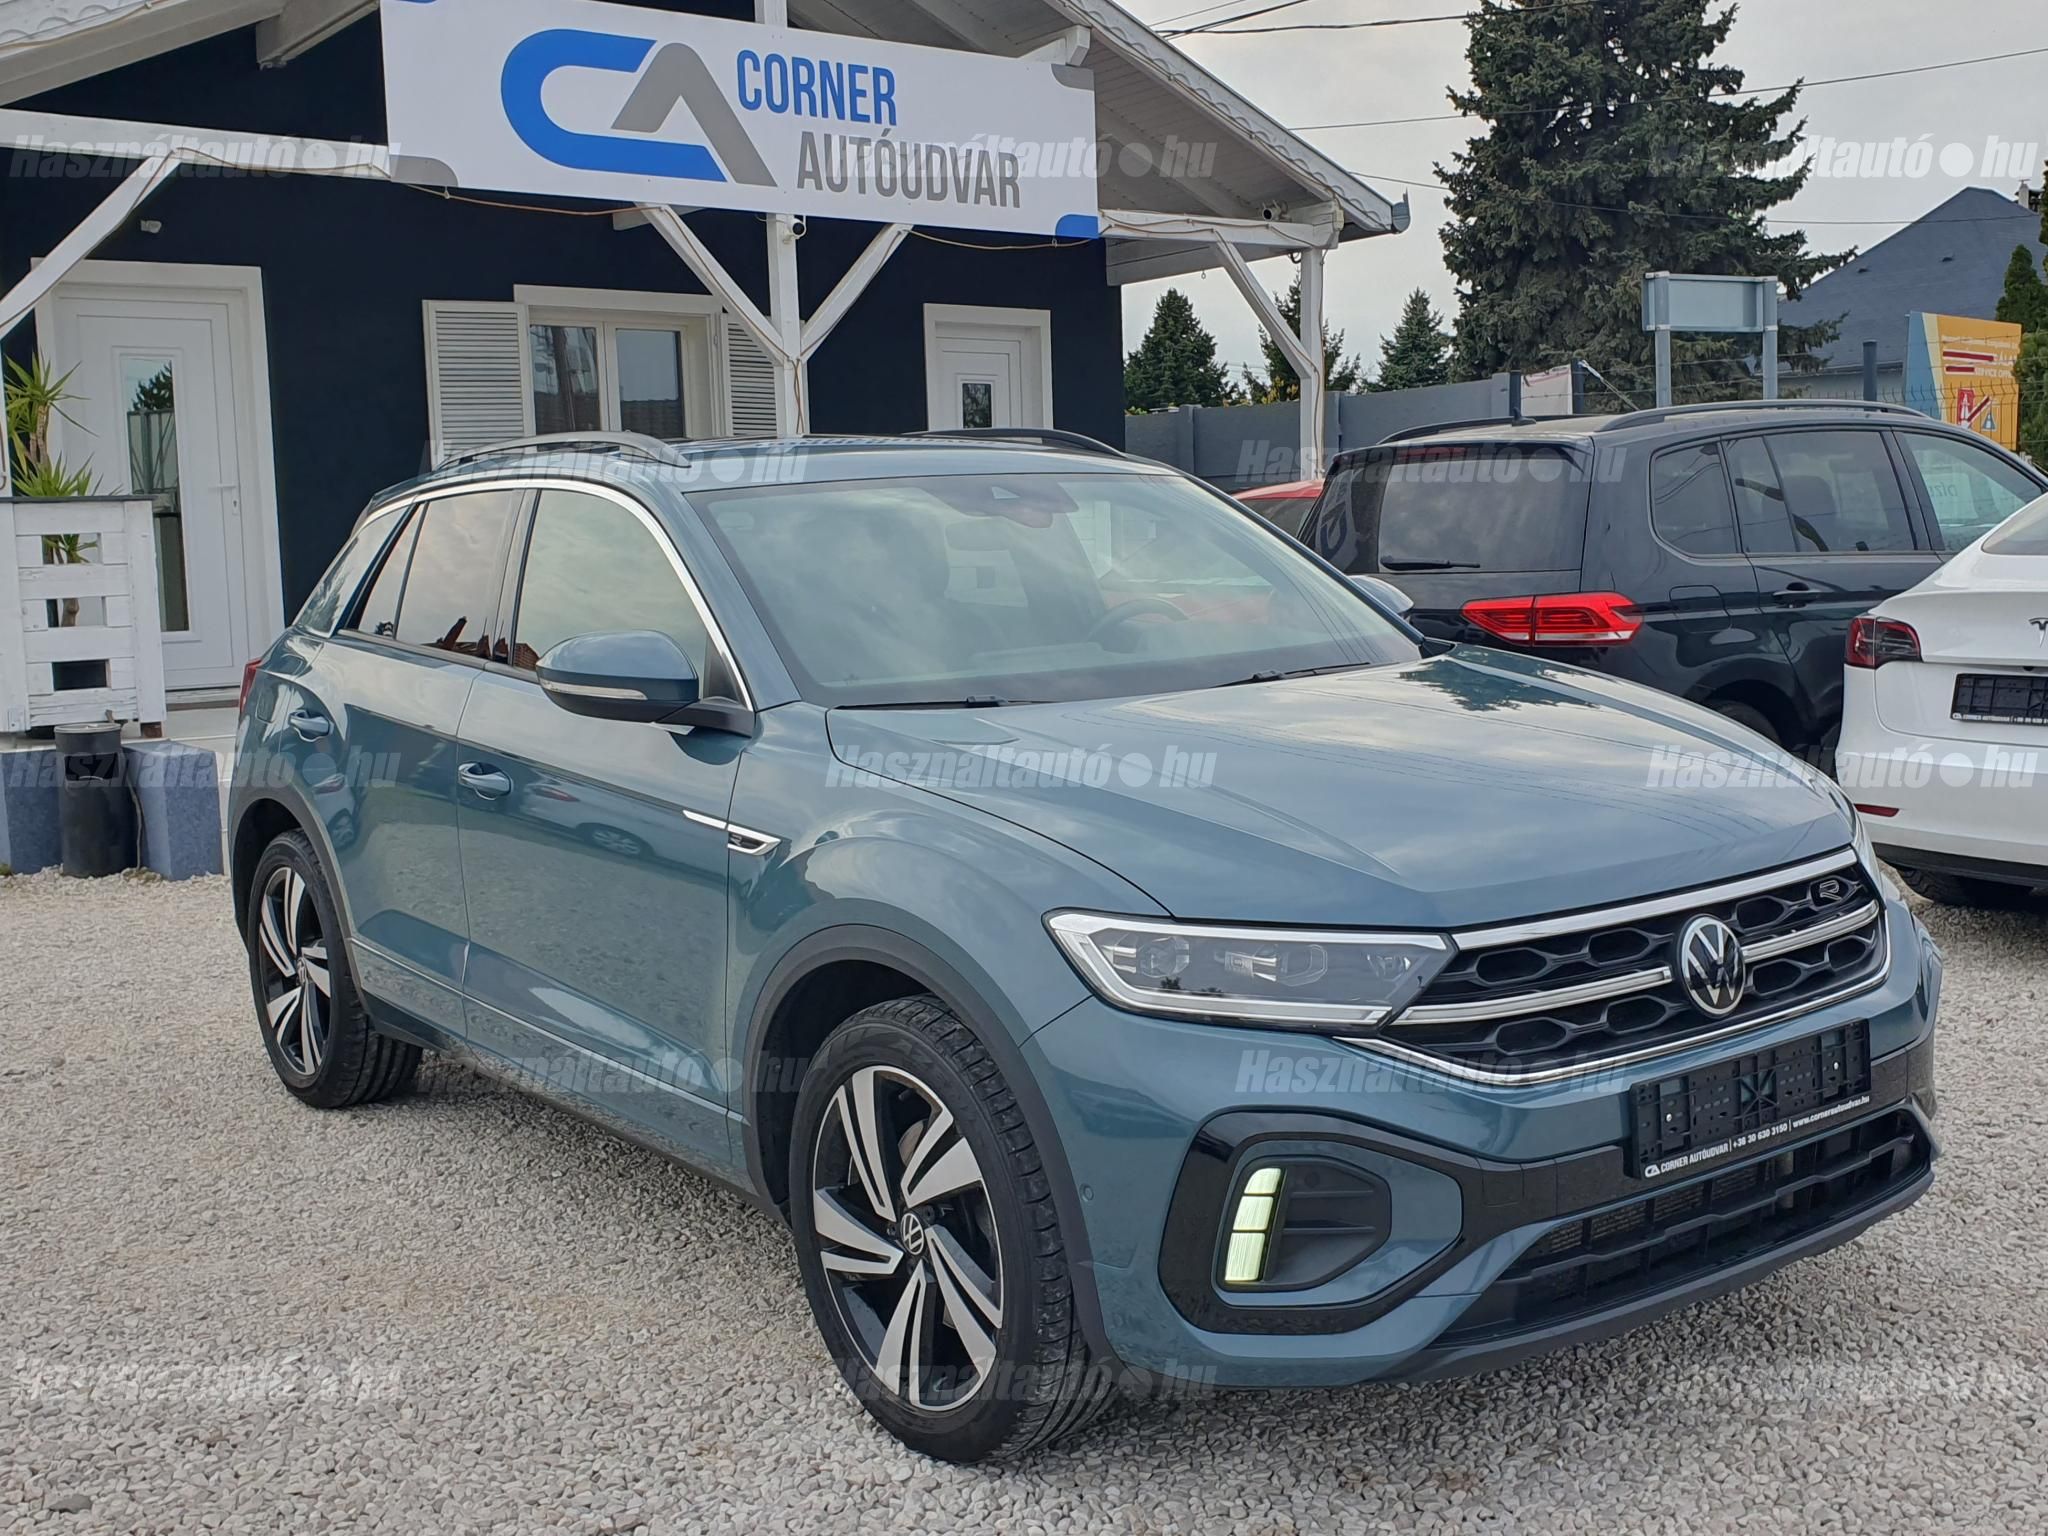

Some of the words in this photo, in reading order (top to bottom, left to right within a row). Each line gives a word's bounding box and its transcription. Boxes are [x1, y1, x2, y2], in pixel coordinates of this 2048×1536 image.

[737, 49, 897, 126] CORNER
[797, 128, 1020, 208] AUTÓUDVAR
[1660, 1155, 1689, 1173] CORNER
[1689, 1142, 1729, 1165] AUTÓUDVAR
